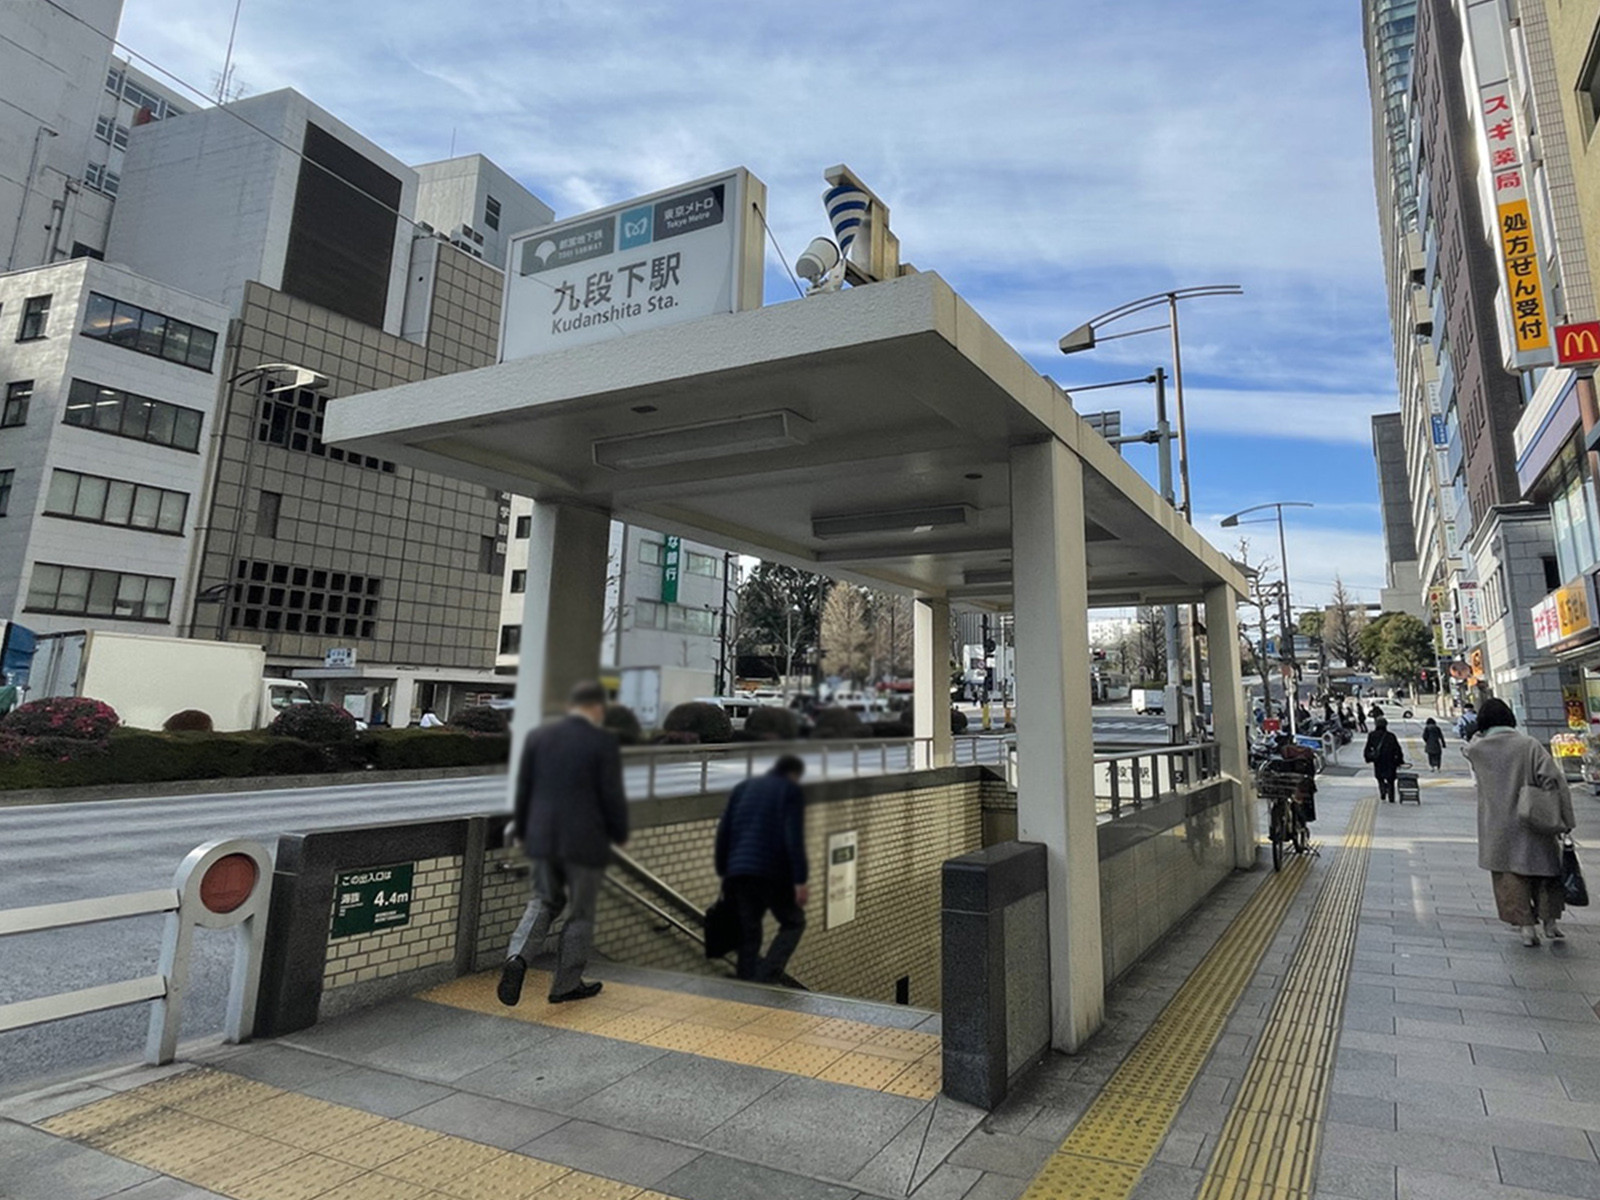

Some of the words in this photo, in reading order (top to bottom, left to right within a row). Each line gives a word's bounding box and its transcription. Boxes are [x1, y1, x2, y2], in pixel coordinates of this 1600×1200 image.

[1484, 94, 1521, 190] スギ薬局
[663, 197, 714, 220] 東京メトロ
[666, 218, 688, 229] Tokyo
[689, 211, 710, 222] Metro
[552, 252, 680, 315] 九段下駅
[1503, 213, 1543, 340] 処方せん受付
[551, 302, 641, 335] Kudanshita
[647, 295, 679, 313] Sta.
[374, 890, 409, 907] 4.4m
